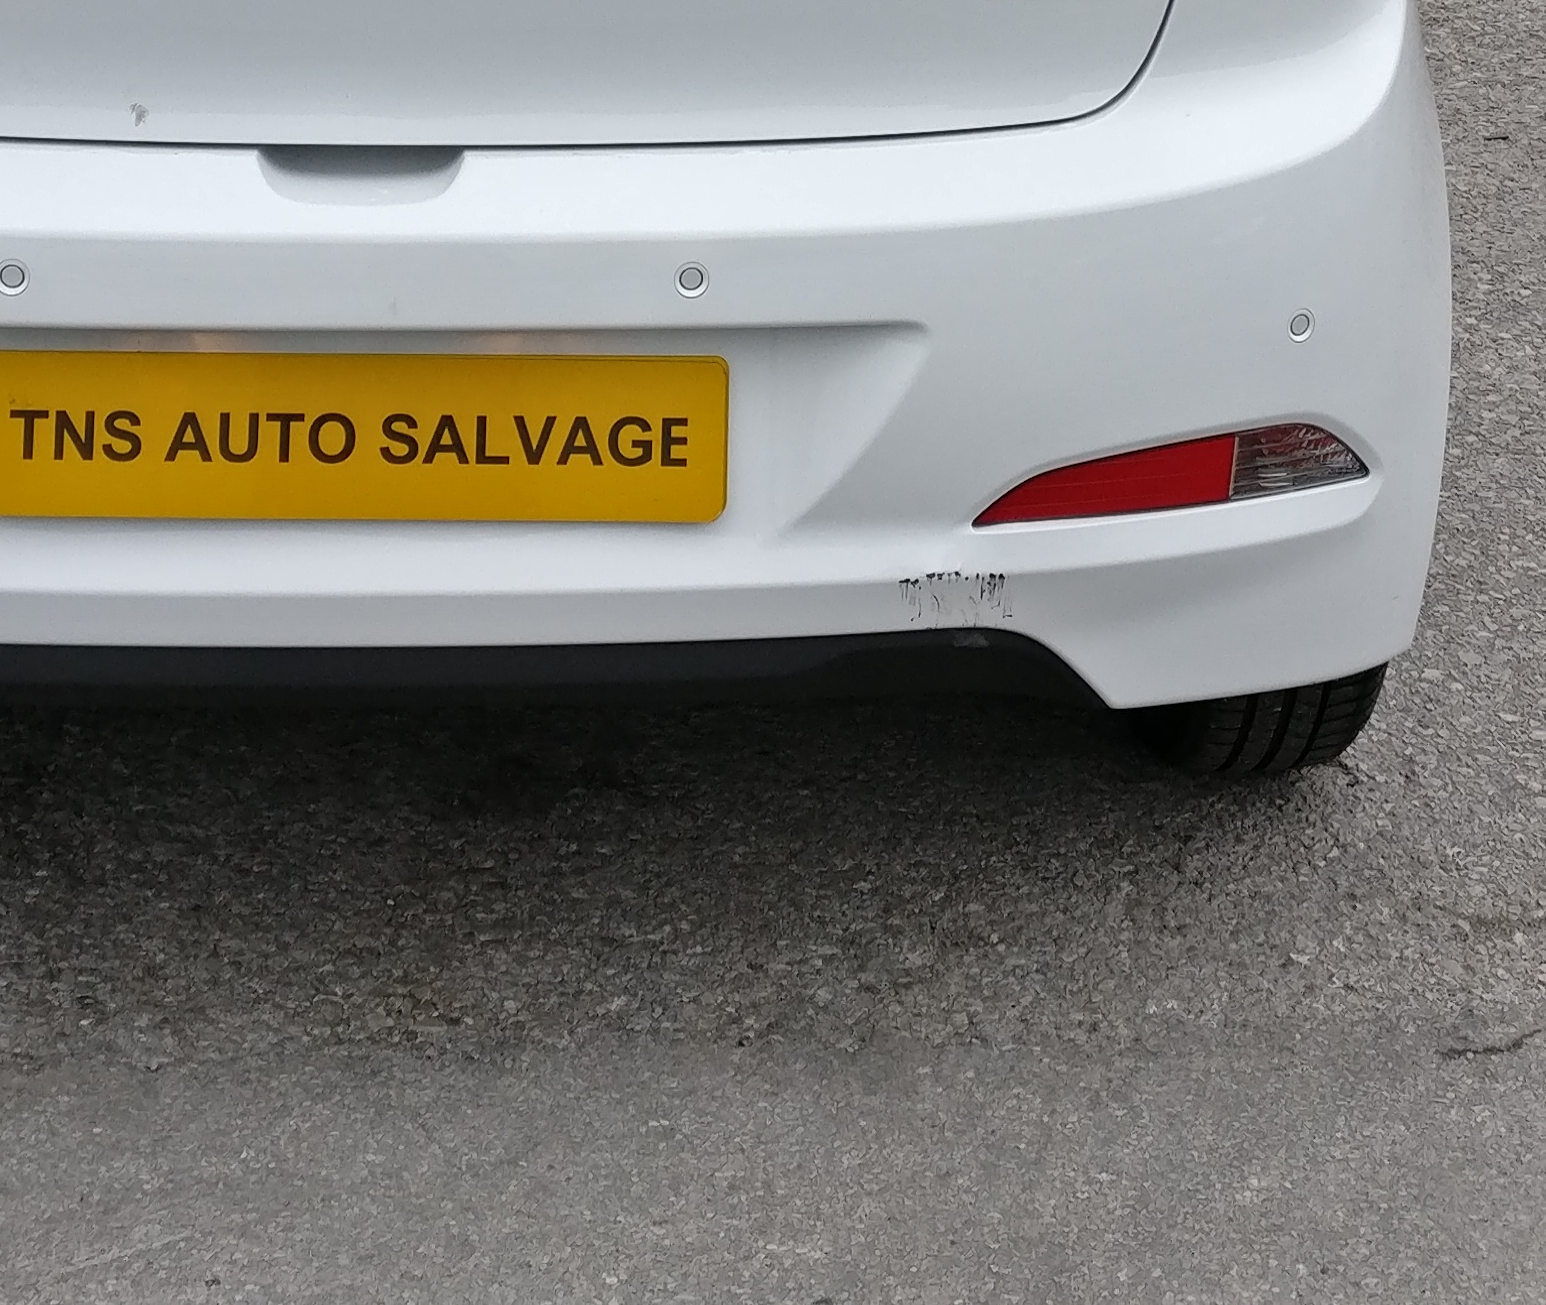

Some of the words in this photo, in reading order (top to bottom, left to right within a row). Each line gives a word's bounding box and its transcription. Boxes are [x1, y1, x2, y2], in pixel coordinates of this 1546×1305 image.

[9, 409, 142, 463] TNS
[164, 411, 357, 466] AUTO
[379, 414, 689, 469] SALVAGE
